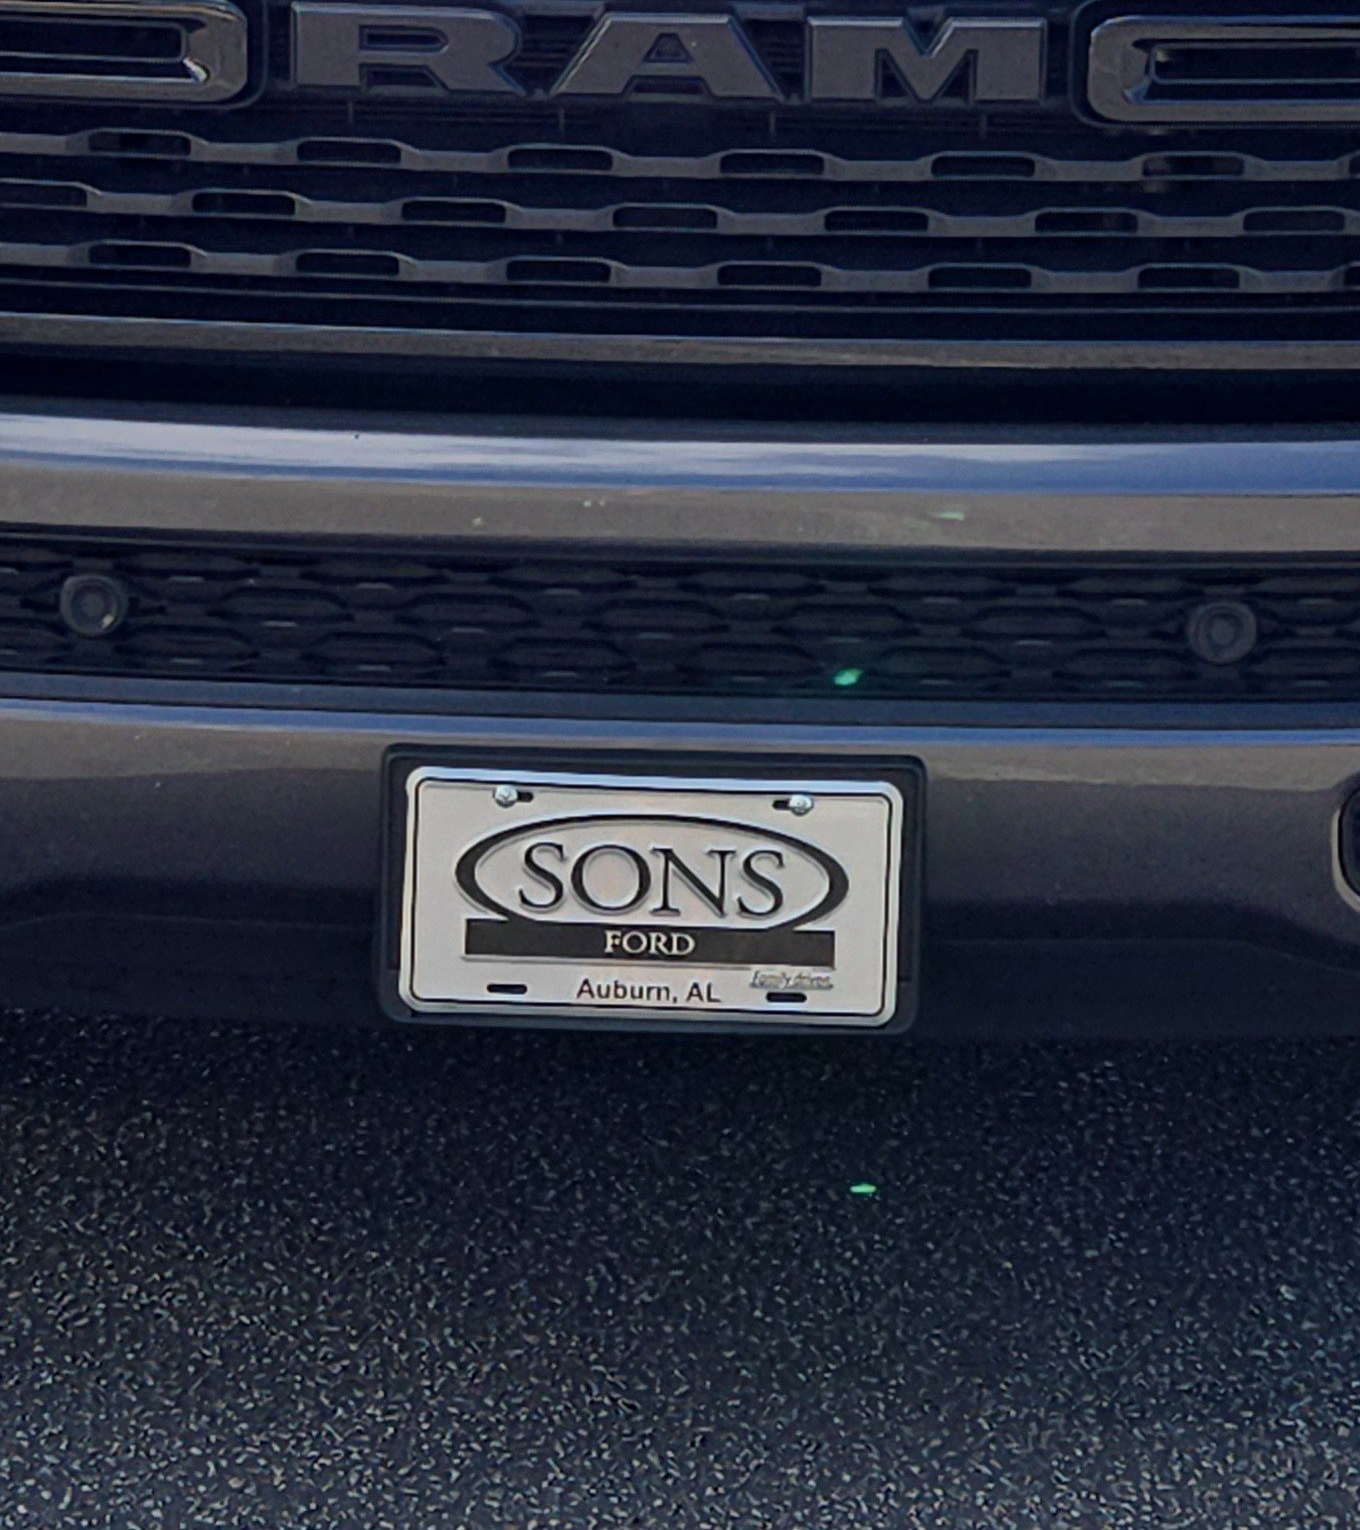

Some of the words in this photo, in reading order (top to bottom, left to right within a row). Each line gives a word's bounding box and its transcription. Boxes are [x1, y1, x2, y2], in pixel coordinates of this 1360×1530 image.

[292, 2, 1047, 102] RAM
[518, 841, 785, 918] SONS
[604, 930, 696, 956] FORD
[576, 978, 678, 1004] Auburn,
[686, 982, 721, 1002] AL
